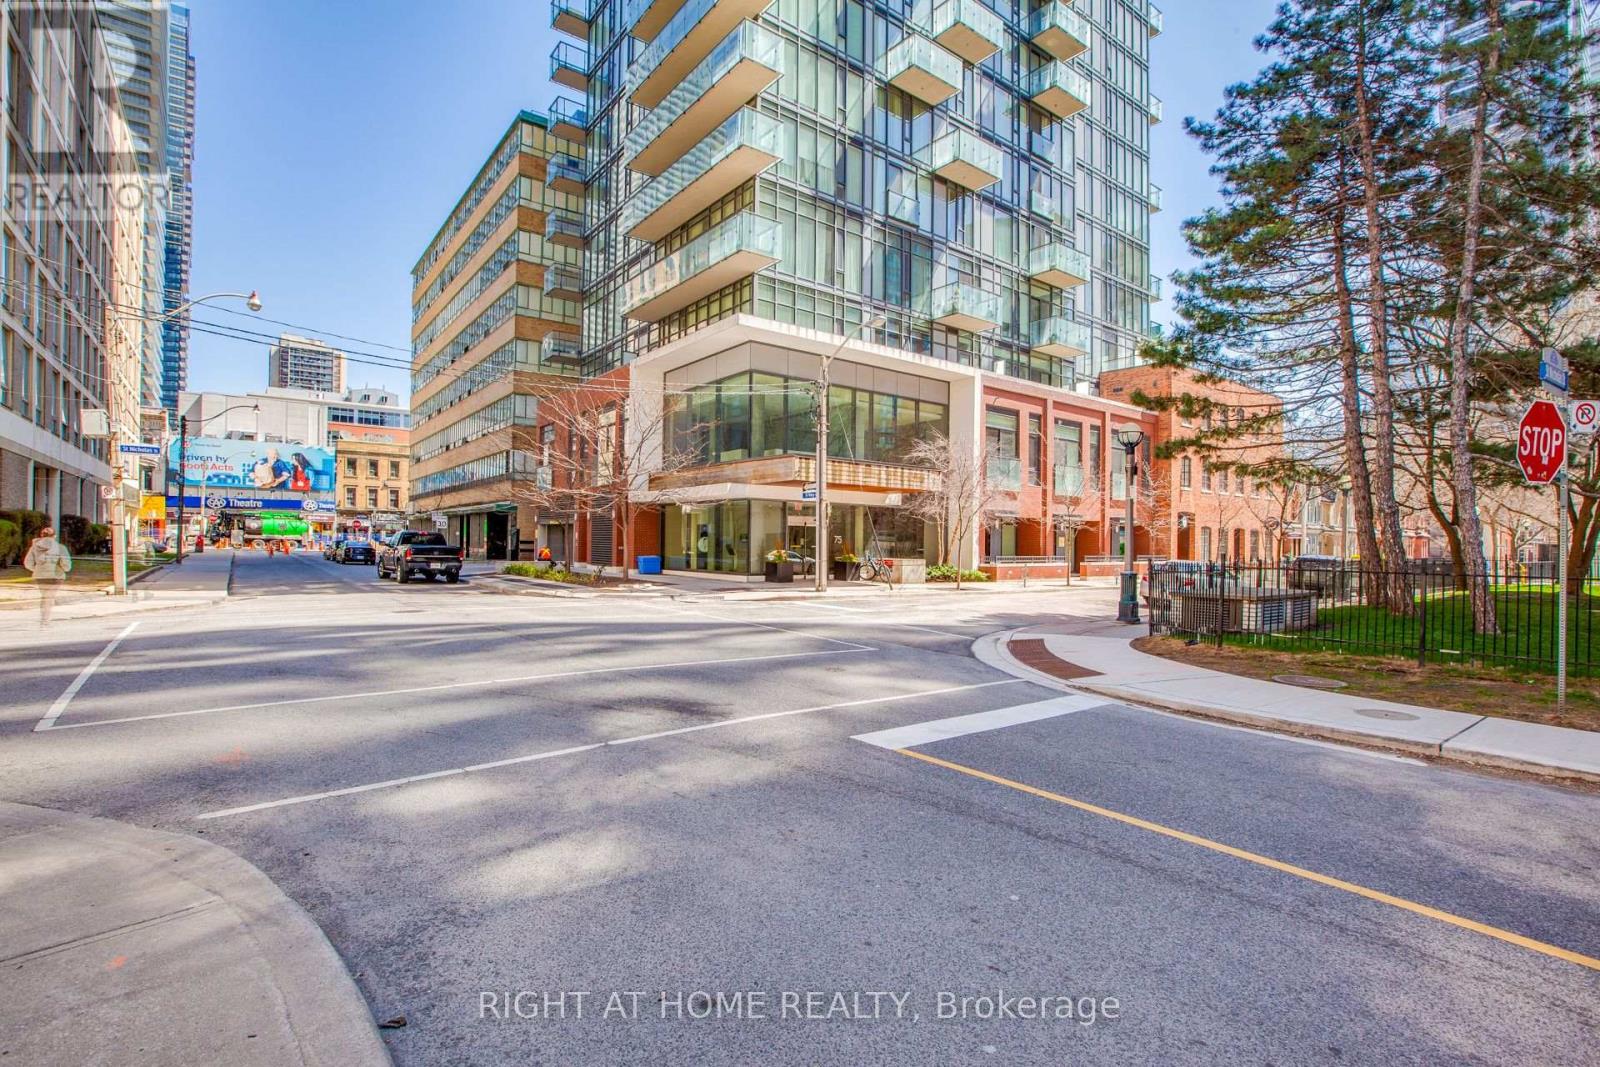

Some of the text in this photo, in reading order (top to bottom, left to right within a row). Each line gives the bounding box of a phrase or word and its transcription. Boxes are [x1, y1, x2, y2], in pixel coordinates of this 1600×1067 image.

[1520, 426, 1563, 458] STOP
[181, 453, 212, 462] riven
[210, 463, 234, 471] Acts
[229, 499, 263, 508] Theatre
[834, 535, 843, 544] 75
